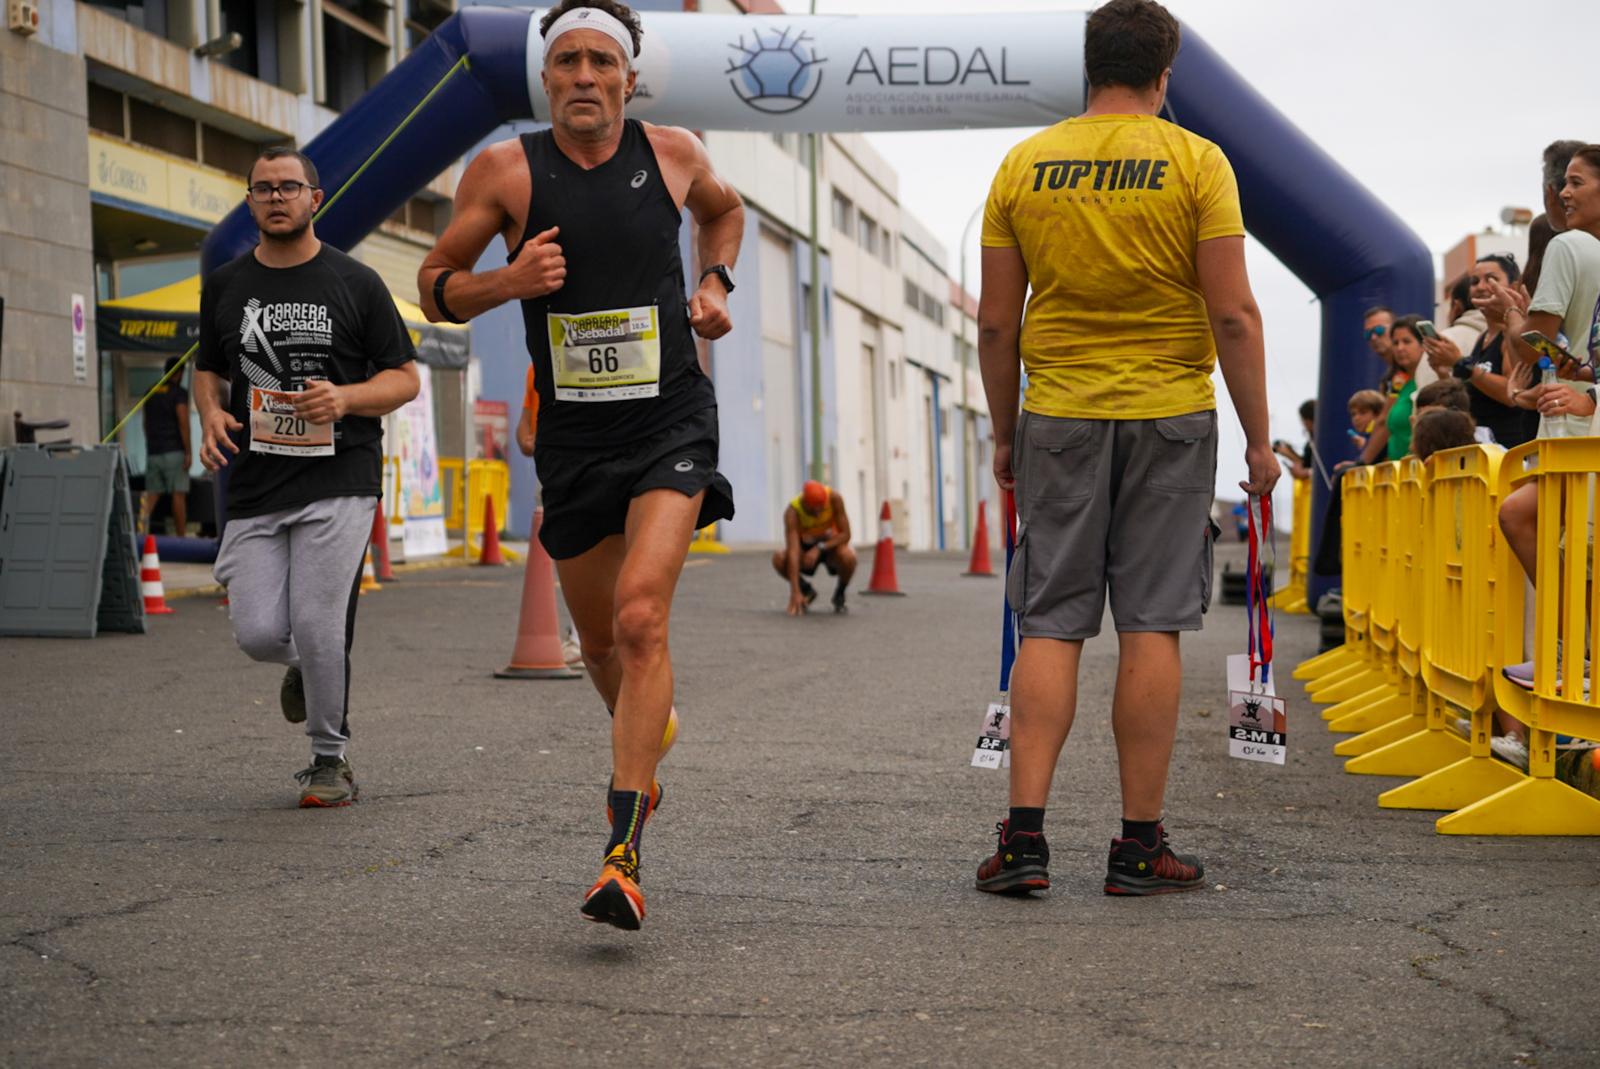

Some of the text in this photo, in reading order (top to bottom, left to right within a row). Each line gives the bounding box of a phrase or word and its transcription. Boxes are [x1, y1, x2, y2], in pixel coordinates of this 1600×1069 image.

[846, 47, 1031, 86] AEDAL
[846, 91, 1029, 104] ASOCIACIÓN EMPRESARIAL
[846, 105, 951, 115] DE EL SEBADAL
[1032, 159, 1169, 192] TOPTIME
[1053, 195, 1141, 205] EVENTOS
[266, 303, 327, 321] CARRERA
[120, 320, 178, 337] TOPTIME
[272, 318, 333, 333] Sebadal
[572, 315, 619, 331] CARRERA
[578, 324, 626, 340] Sebadal
[588, 346, 619, 374] 66
[274, 415, 306, 437] 220
[980, 738, 1001, 750] 2-F
[1235, 728, 1267, 744] 2-M
